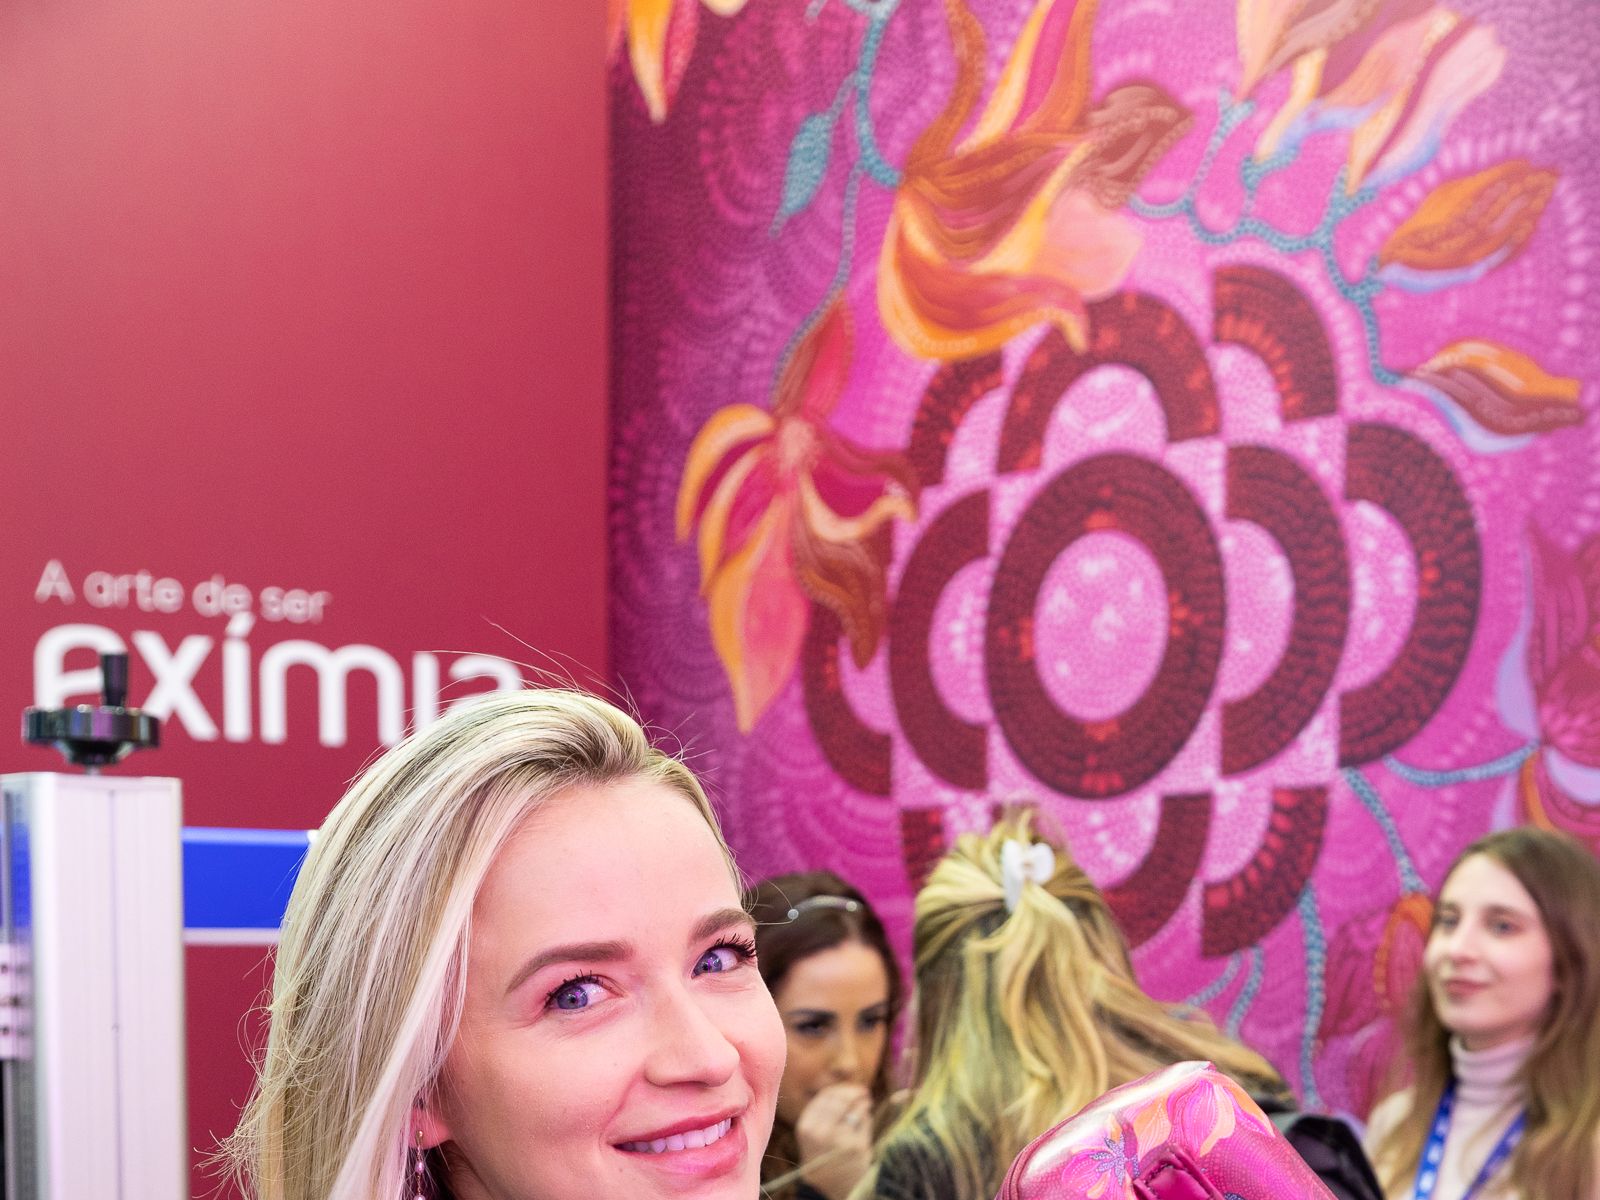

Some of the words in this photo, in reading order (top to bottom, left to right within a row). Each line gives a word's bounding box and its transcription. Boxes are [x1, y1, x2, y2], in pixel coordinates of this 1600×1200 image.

[34, 559, 76, 604] A
[83, 569, 185, 614] arte
[192, 573, 253, 618] de
[260, 586, 333, 625] ser
